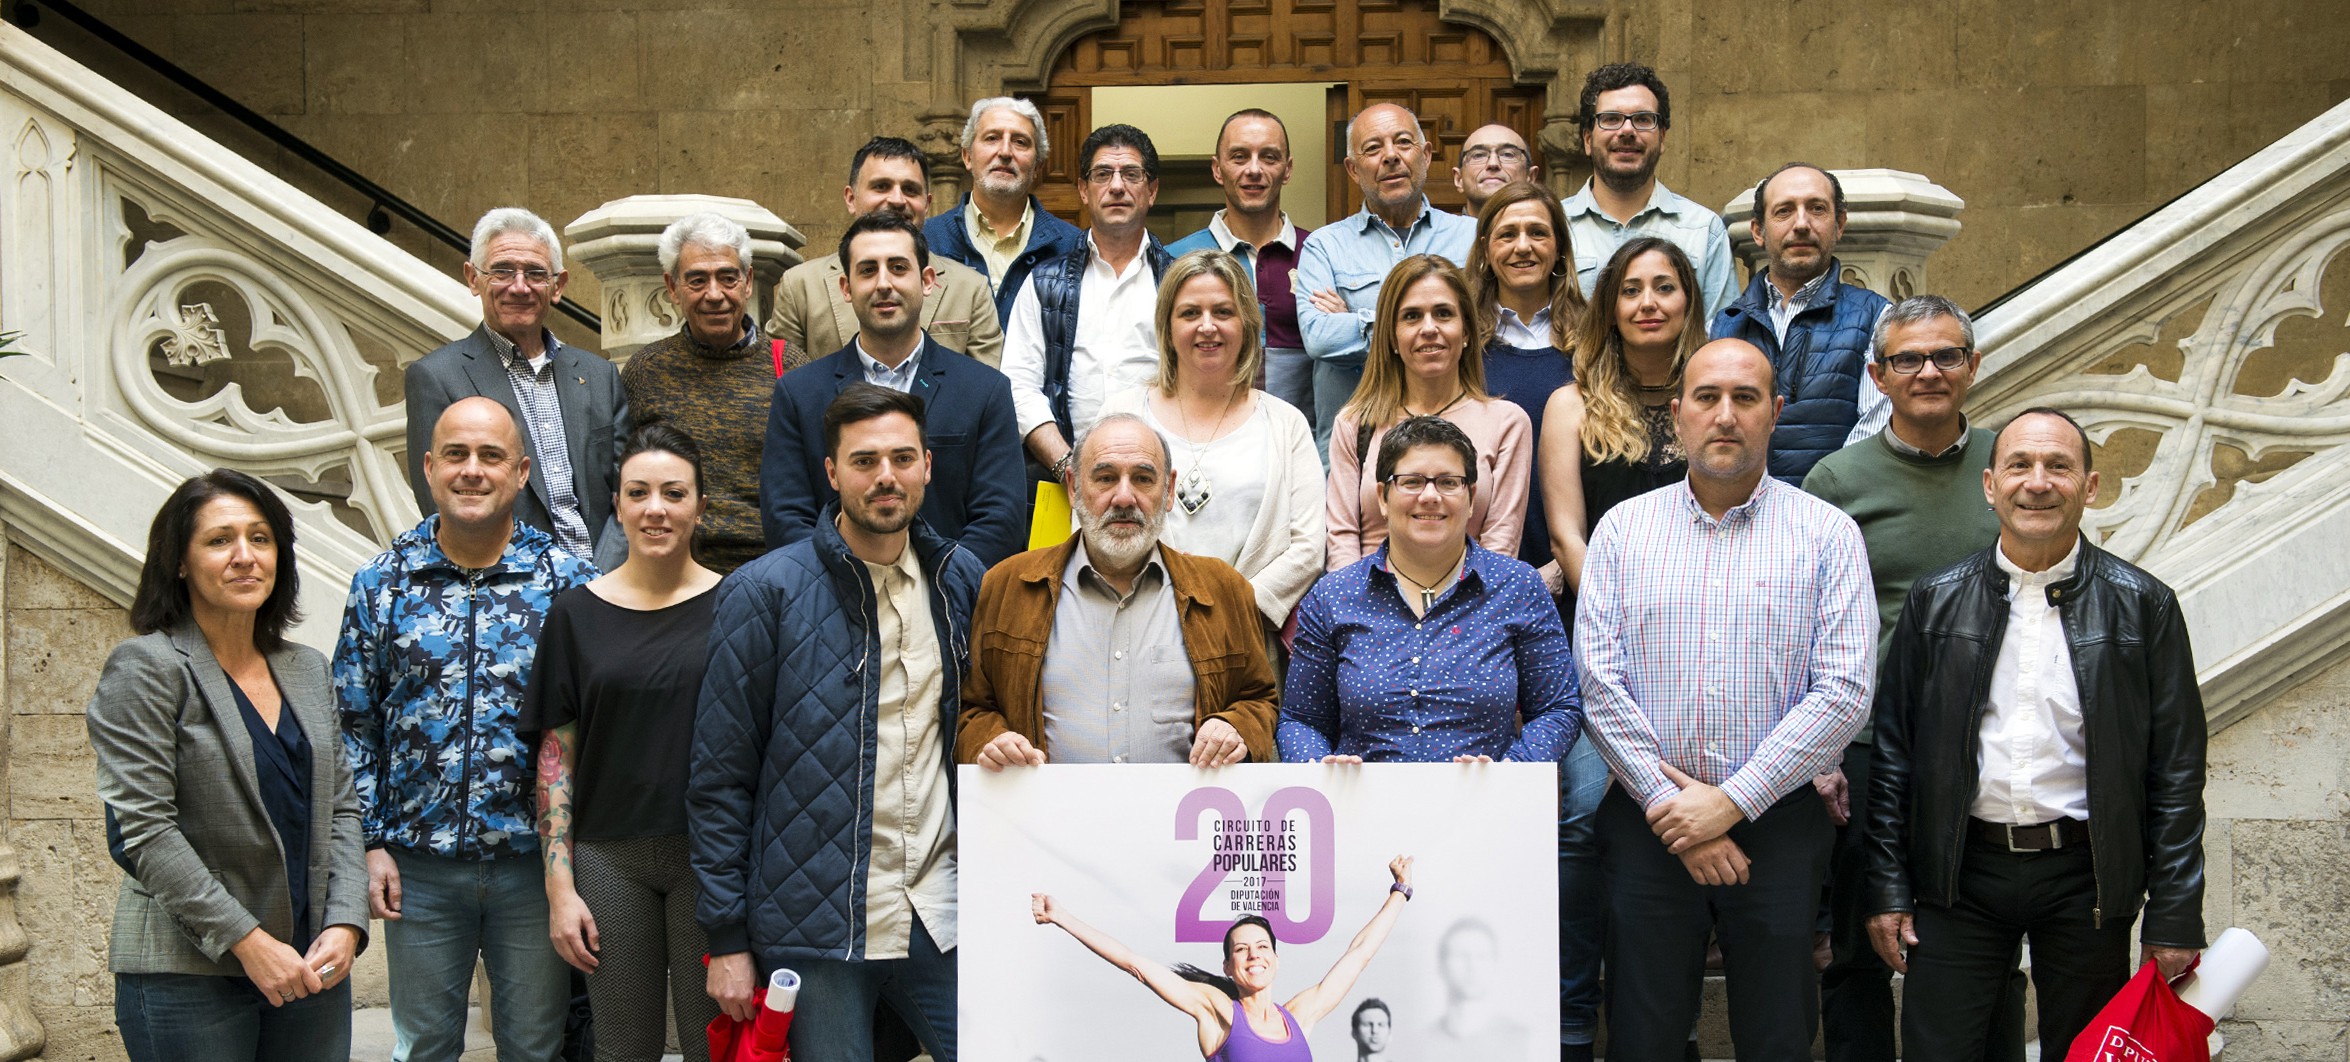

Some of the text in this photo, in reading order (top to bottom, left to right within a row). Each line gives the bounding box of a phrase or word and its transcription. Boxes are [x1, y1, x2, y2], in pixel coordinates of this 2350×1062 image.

[1214, 820, 1295, 832] CIRCUITO DE
[1213, 835, 1296, 851] CARRERAS
[1175, 786, 1335, 944] 20
[1213, 854, 1297, 872] POPULARES
[1243, 876, 1267, 887] 2017
[1231, 888, 1280, 900] DIPUTACIÓN
[1231, 901, 1280, 911] DE VALENCIA
